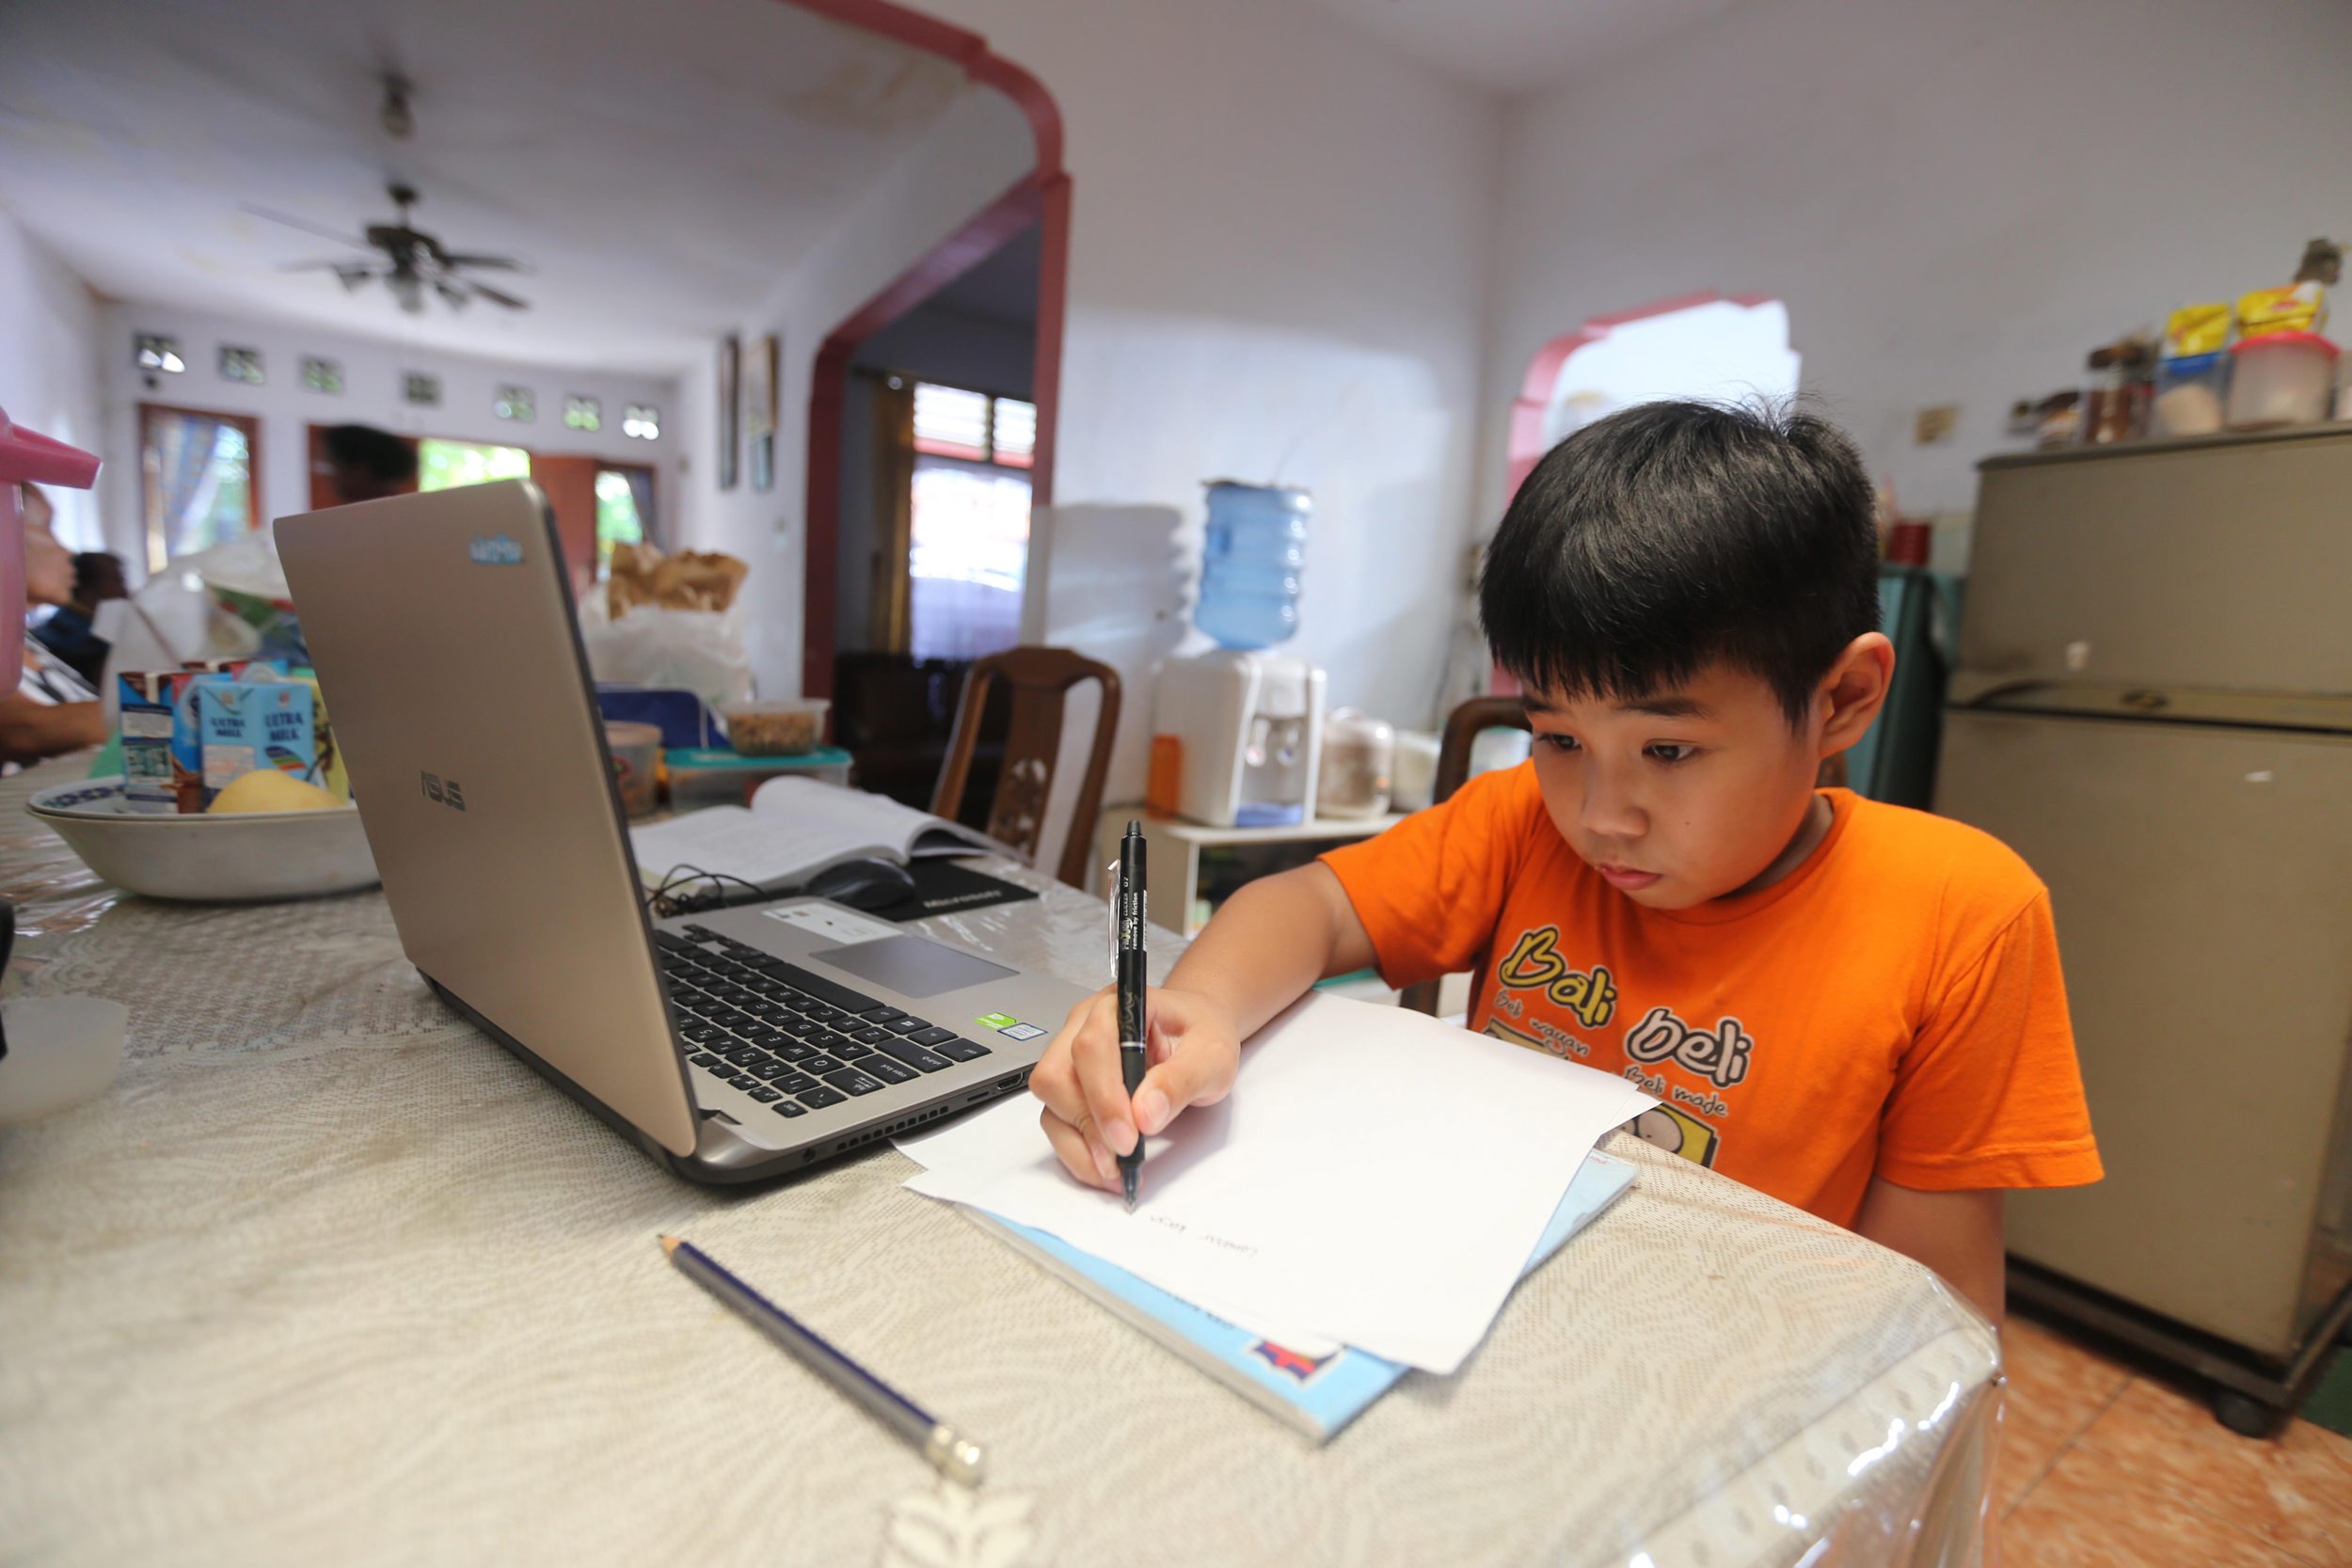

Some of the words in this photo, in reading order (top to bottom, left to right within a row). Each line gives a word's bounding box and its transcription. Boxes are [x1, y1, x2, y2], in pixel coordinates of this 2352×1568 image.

[1500, 925, 1617, 1028] Bali
[1626, 1006, 1753, 1088] beli
[1674, 1086, 1727, 1117] made
